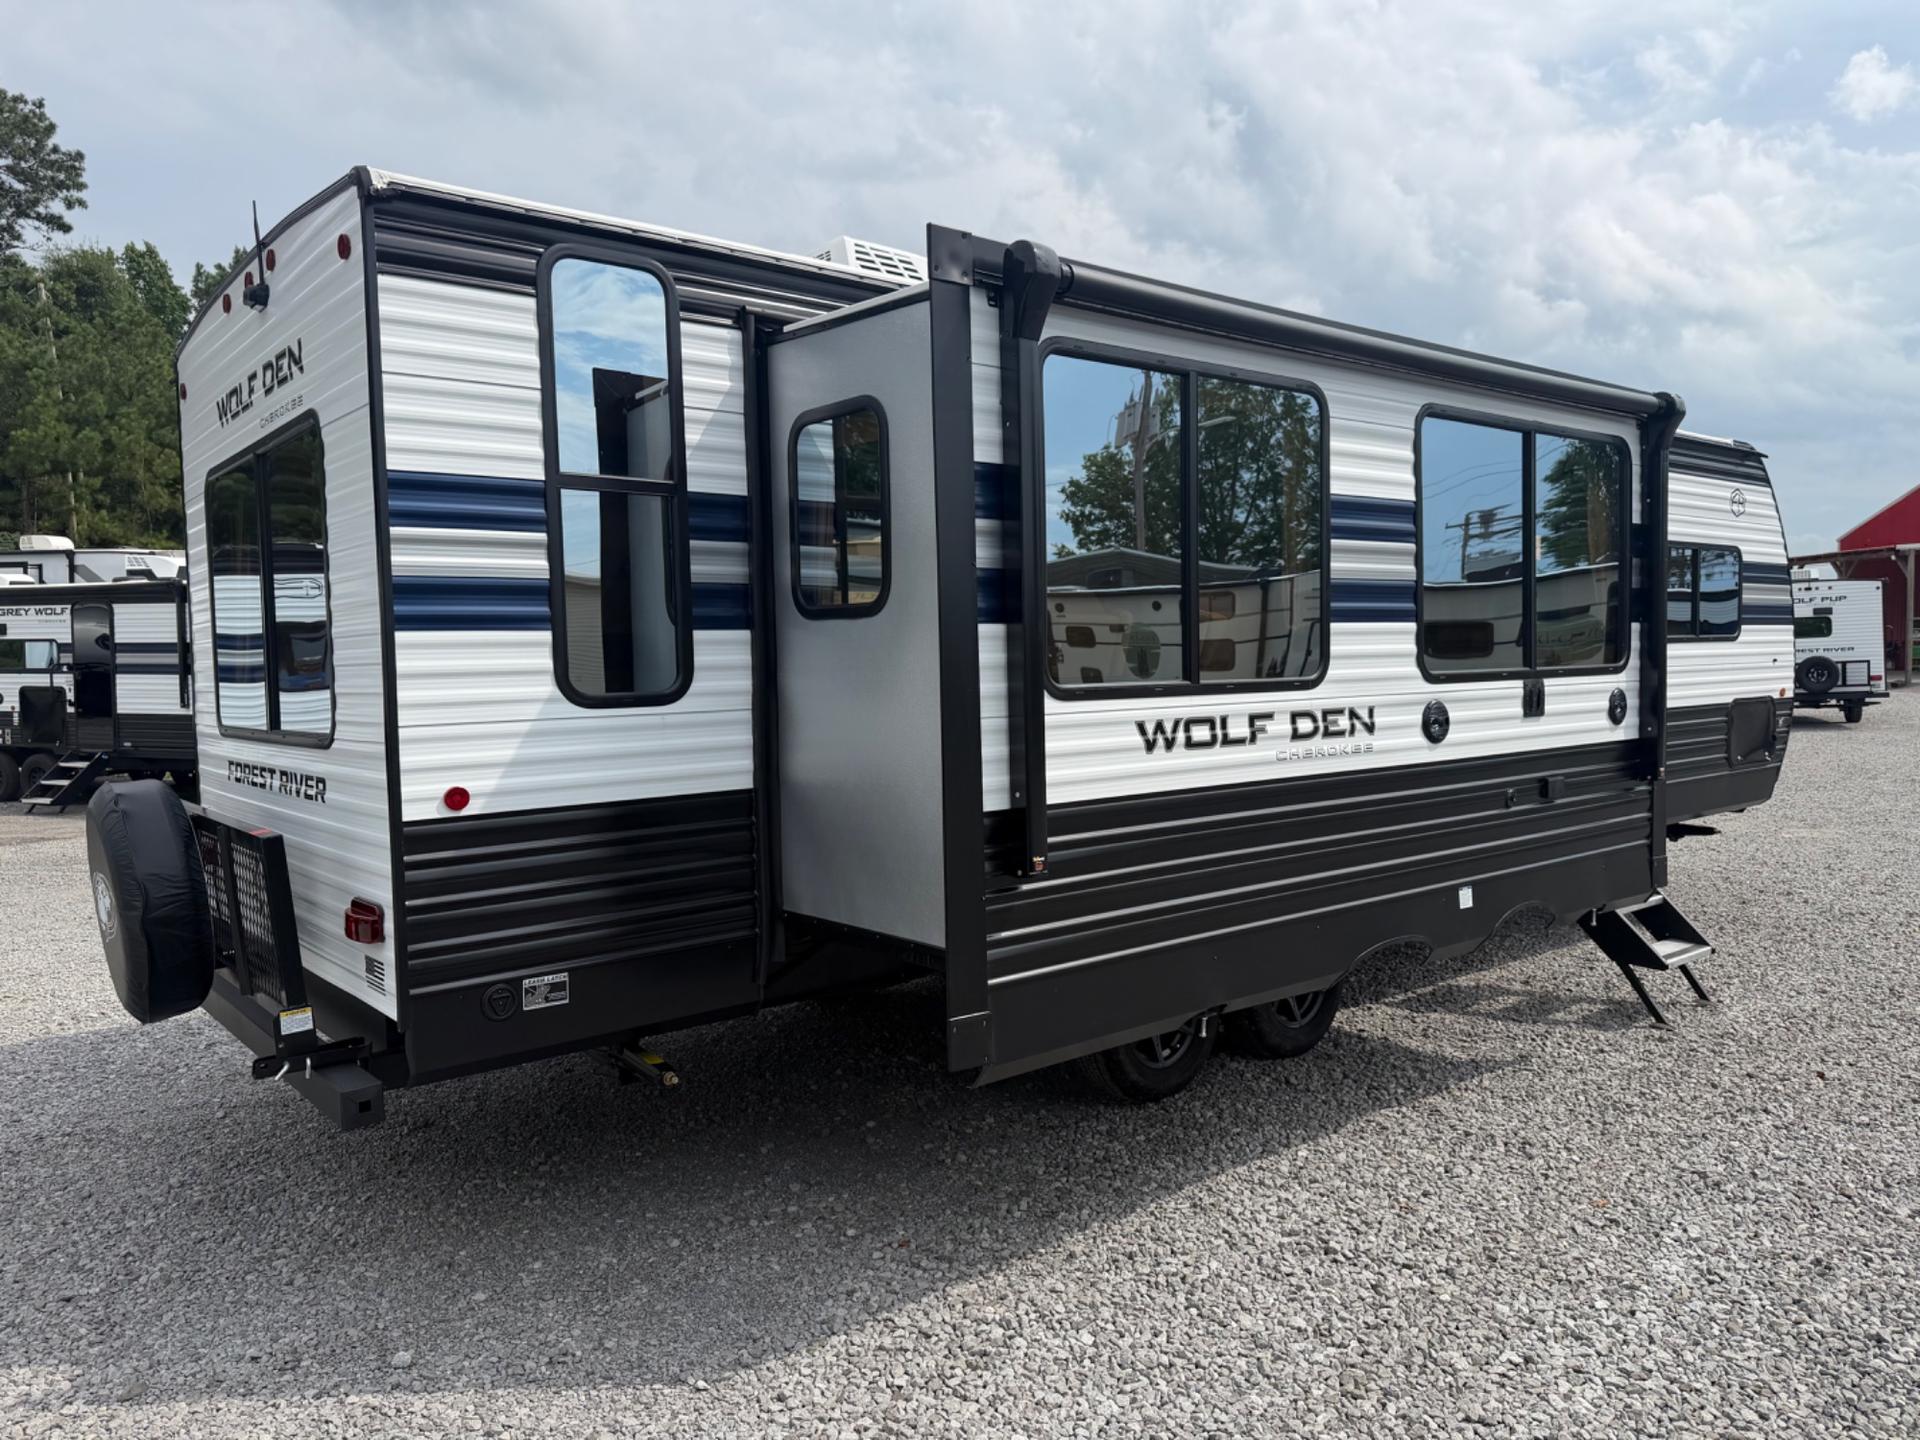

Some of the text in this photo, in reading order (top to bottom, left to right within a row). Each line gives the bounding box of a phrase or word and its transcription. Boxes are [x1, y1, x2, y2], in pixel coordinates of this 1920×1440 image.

[216, 337, 304, 429] WOLF DEN
[0, 607, 68, 617] GREY WOLF
[1134, 705, 1376, 755] WOLF DEN
[1275, 743, 1374, 762] CHEROKEE
[228, 760, 327, 804] FOREST RIVER
